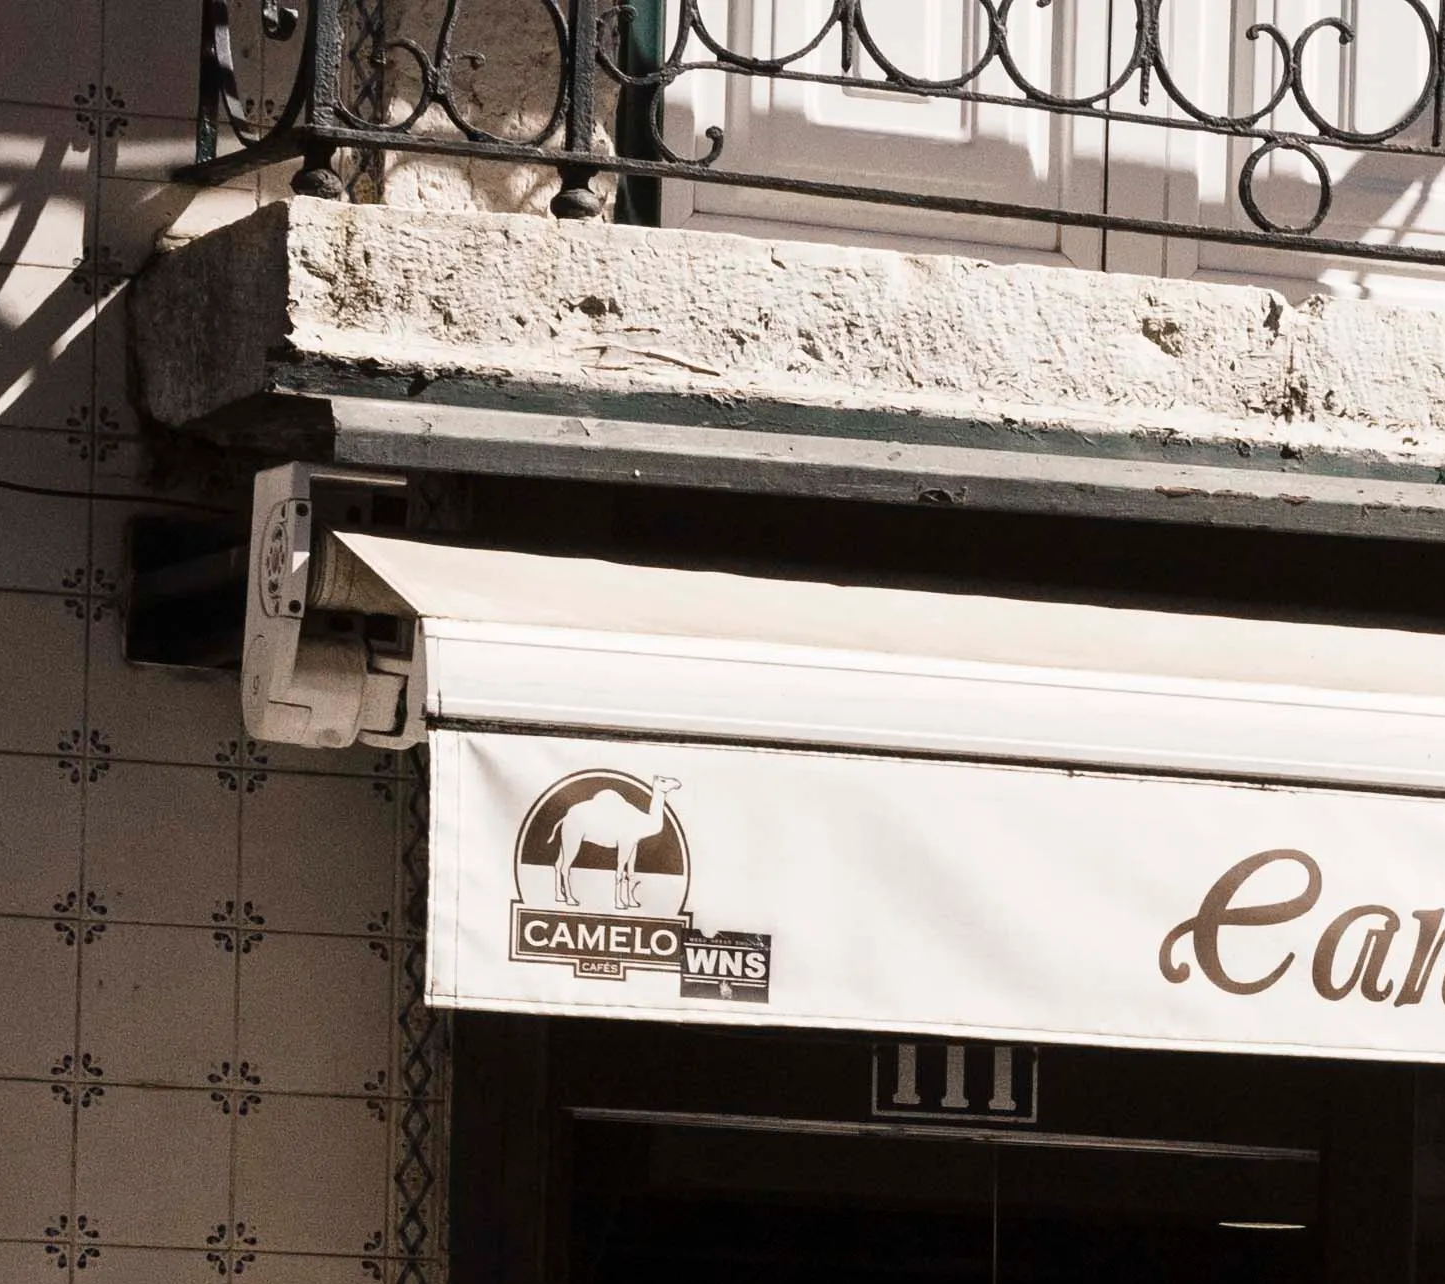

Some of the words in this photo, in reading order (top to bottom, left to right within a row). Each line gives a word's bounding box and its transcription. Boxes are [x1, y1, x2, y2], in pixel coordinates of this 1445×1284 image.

[523, 919, 678, 956] CAMELO
[581, 962, 619, 974] CAFÉS
[685, 947, 767, 979] WNS
